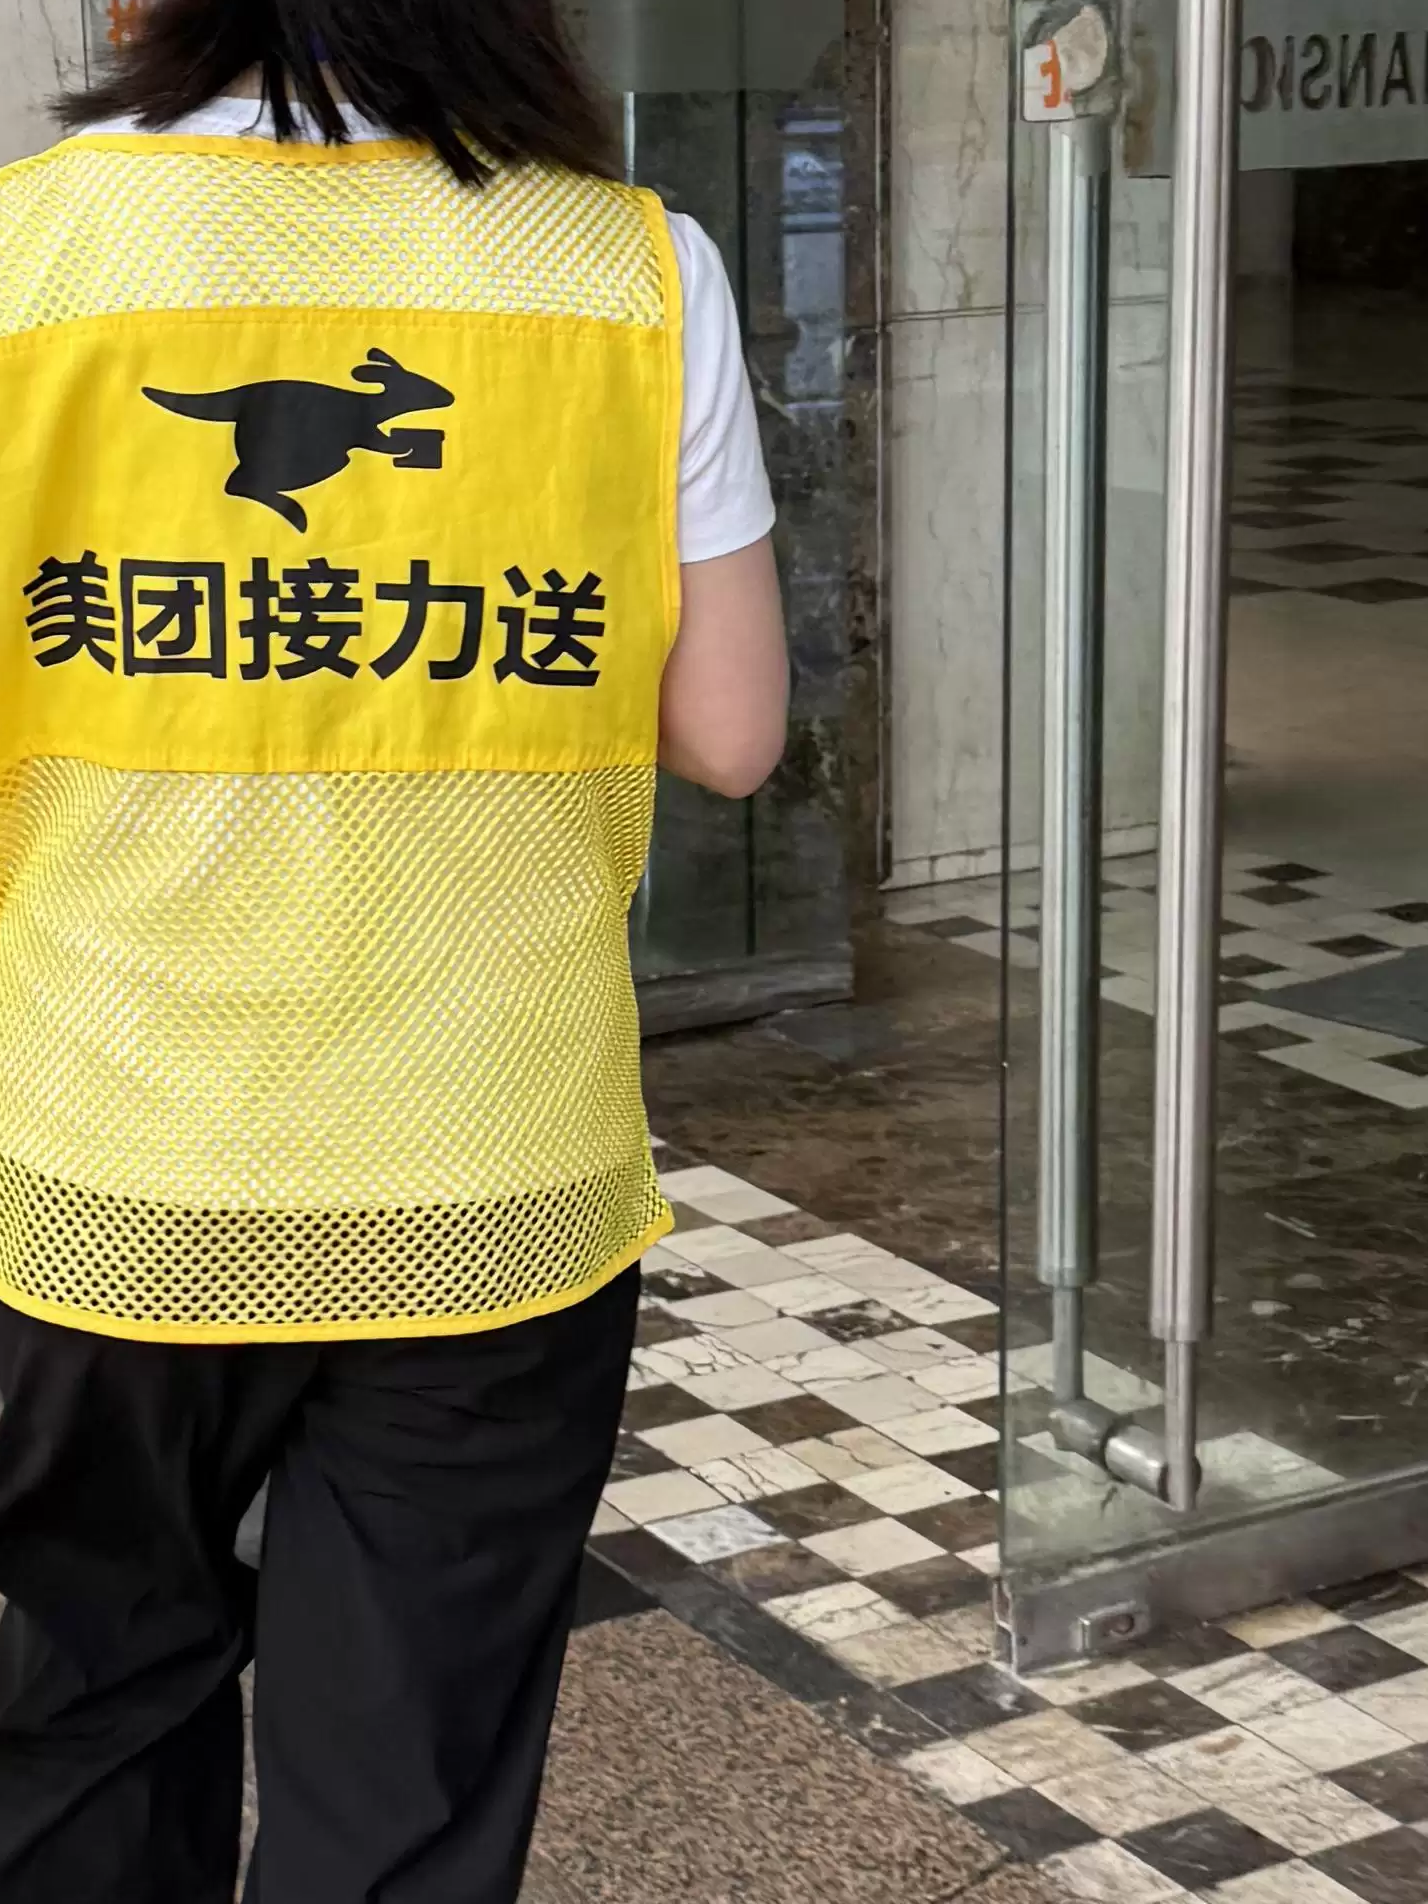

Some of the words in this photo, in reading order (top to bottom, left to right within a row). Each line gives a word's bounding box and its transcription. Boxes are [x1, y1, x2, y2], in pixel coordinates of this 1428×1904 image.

[22, 549, 606, 687] 美团接力送
